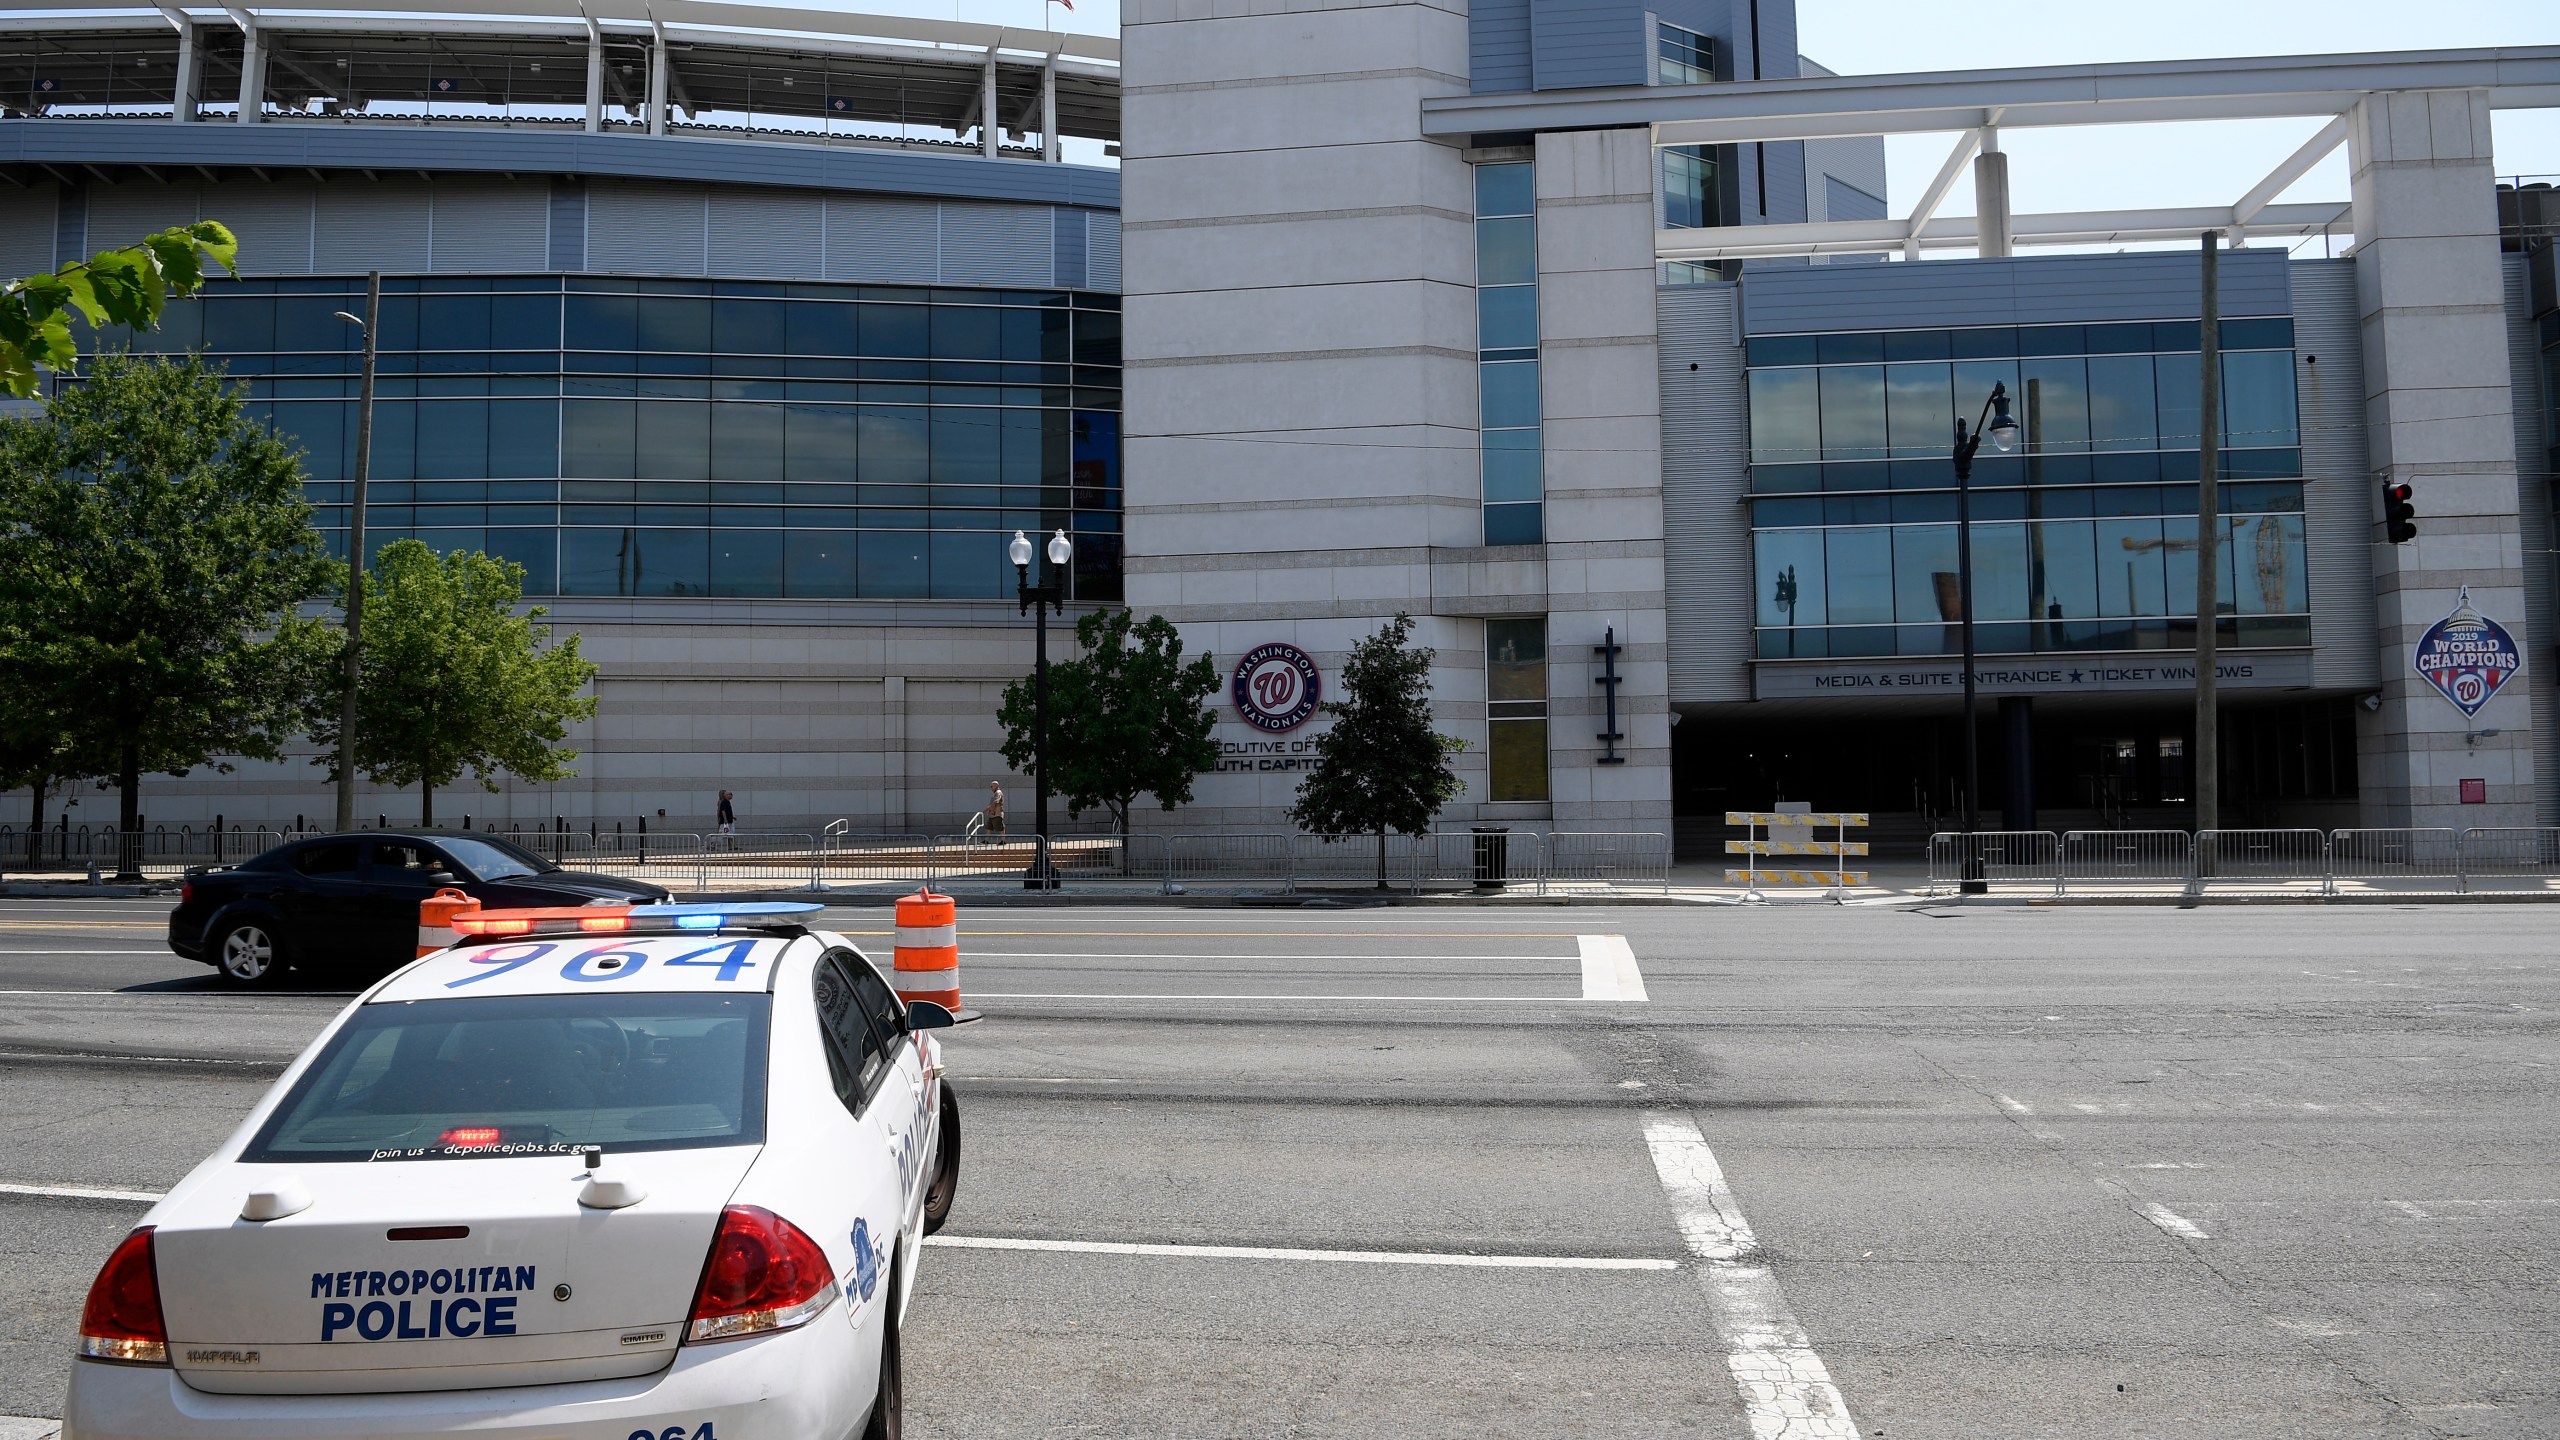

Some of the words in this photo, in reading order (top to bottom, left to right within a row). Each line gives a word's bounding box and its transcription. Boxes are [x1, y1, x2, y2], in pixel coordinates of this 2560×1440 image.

[2433, 639, 2500, 653] WORLD
[2452, 632, 2478, 641] 2019
[1238, 647, 1315, 679] WASHINGTON
[2419, 652, 2516, 671] CHAMPIONS
[1815, 675, 1874, 688] MEDIA
[1879, 675, 1893, 686] &
[1899, 673, 1952, 686] SUITE
[1958, 670, 2062, 684] ENTRANCE
[2089, 668, 2156, 681] TICKET
[2160, 666, 2253, 680] WINOWS
[1242, 702, 1312, 728] NATIONALS
[1219, 742, 1285, 754] CUTIVE
[443, 939, 760, 989] 964
[368, 1148, 401, 1162] Join
[407, 1147, 424, 1157] us
[444, 1141, 588, 1158] dcpolicejobs.dc.go
[311, 1265, 536, 1298] METROPOLITAN
[846, 1277, 858, 1308] MP
[321, 1297, 518, 1341] POLICE
[623, 1333, 664, 1343] LIMITED
